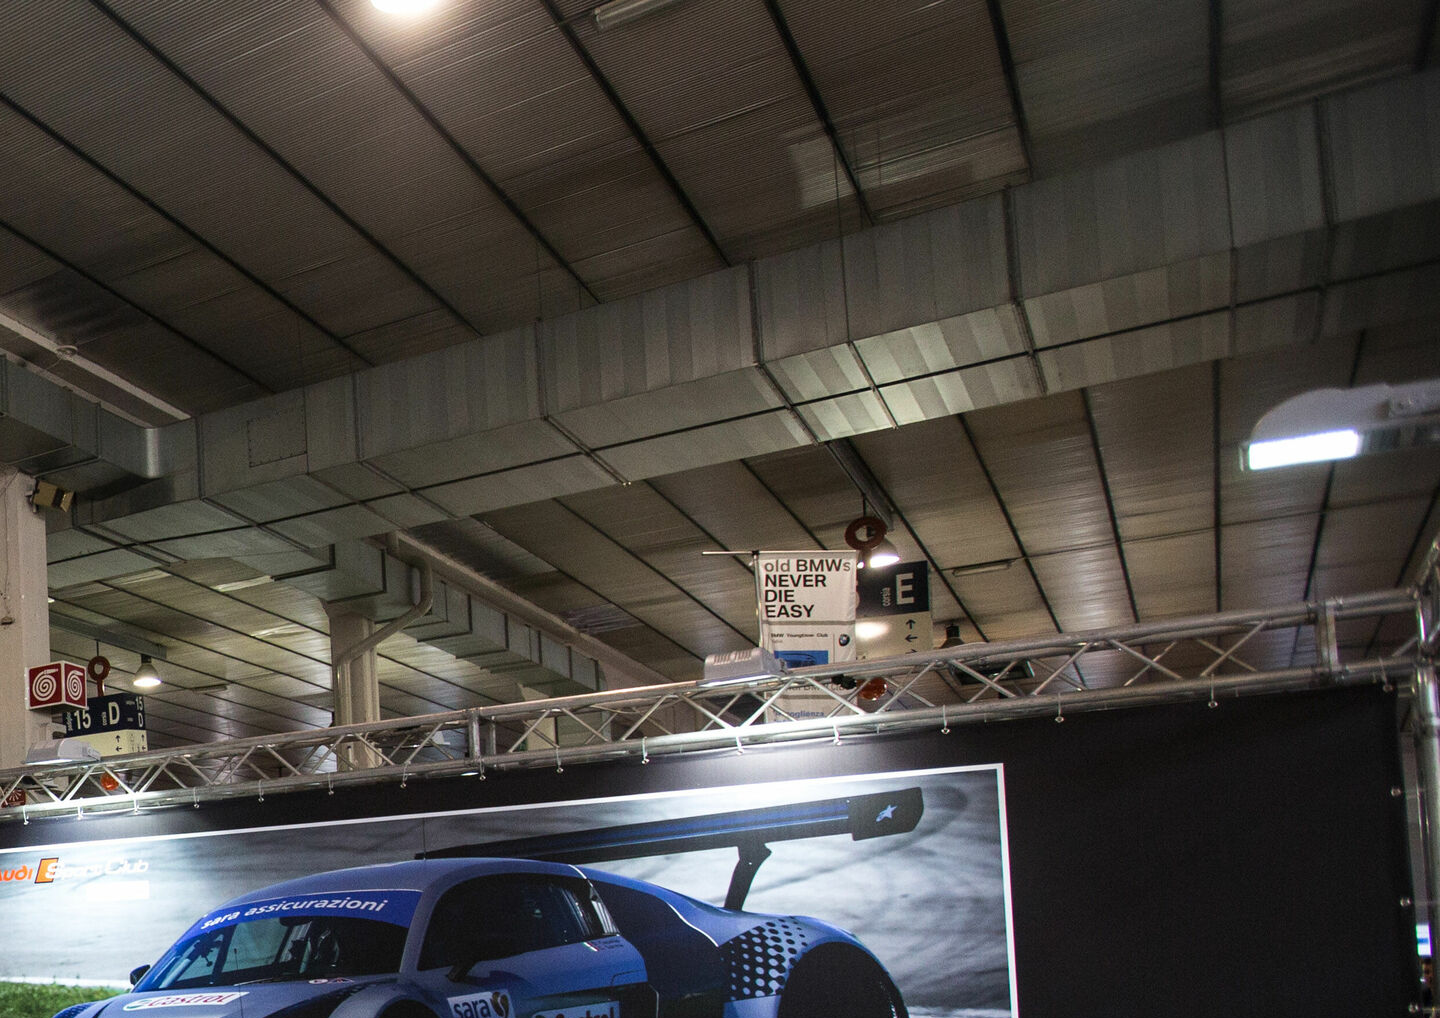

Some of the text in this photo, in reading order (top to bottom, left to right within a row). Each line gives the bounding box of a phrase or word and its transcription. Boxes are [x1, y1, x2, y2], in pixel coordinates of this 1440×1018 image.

[764, 559, 851, 572] old BMWs
[765, 574, 827, 587] NEVER
[765, 589, 795, 602] DIE
[896, 572, 915, 605] E
[765, 604, 815, 618] EASY
[136, 696, 144, 711] 15
[108, 701, 120, 725] D
[137, 712, 144, 728] D
[200, 896, 389, 930] sara assicurazioni
[148, 993, 236, 1007] Castrol
